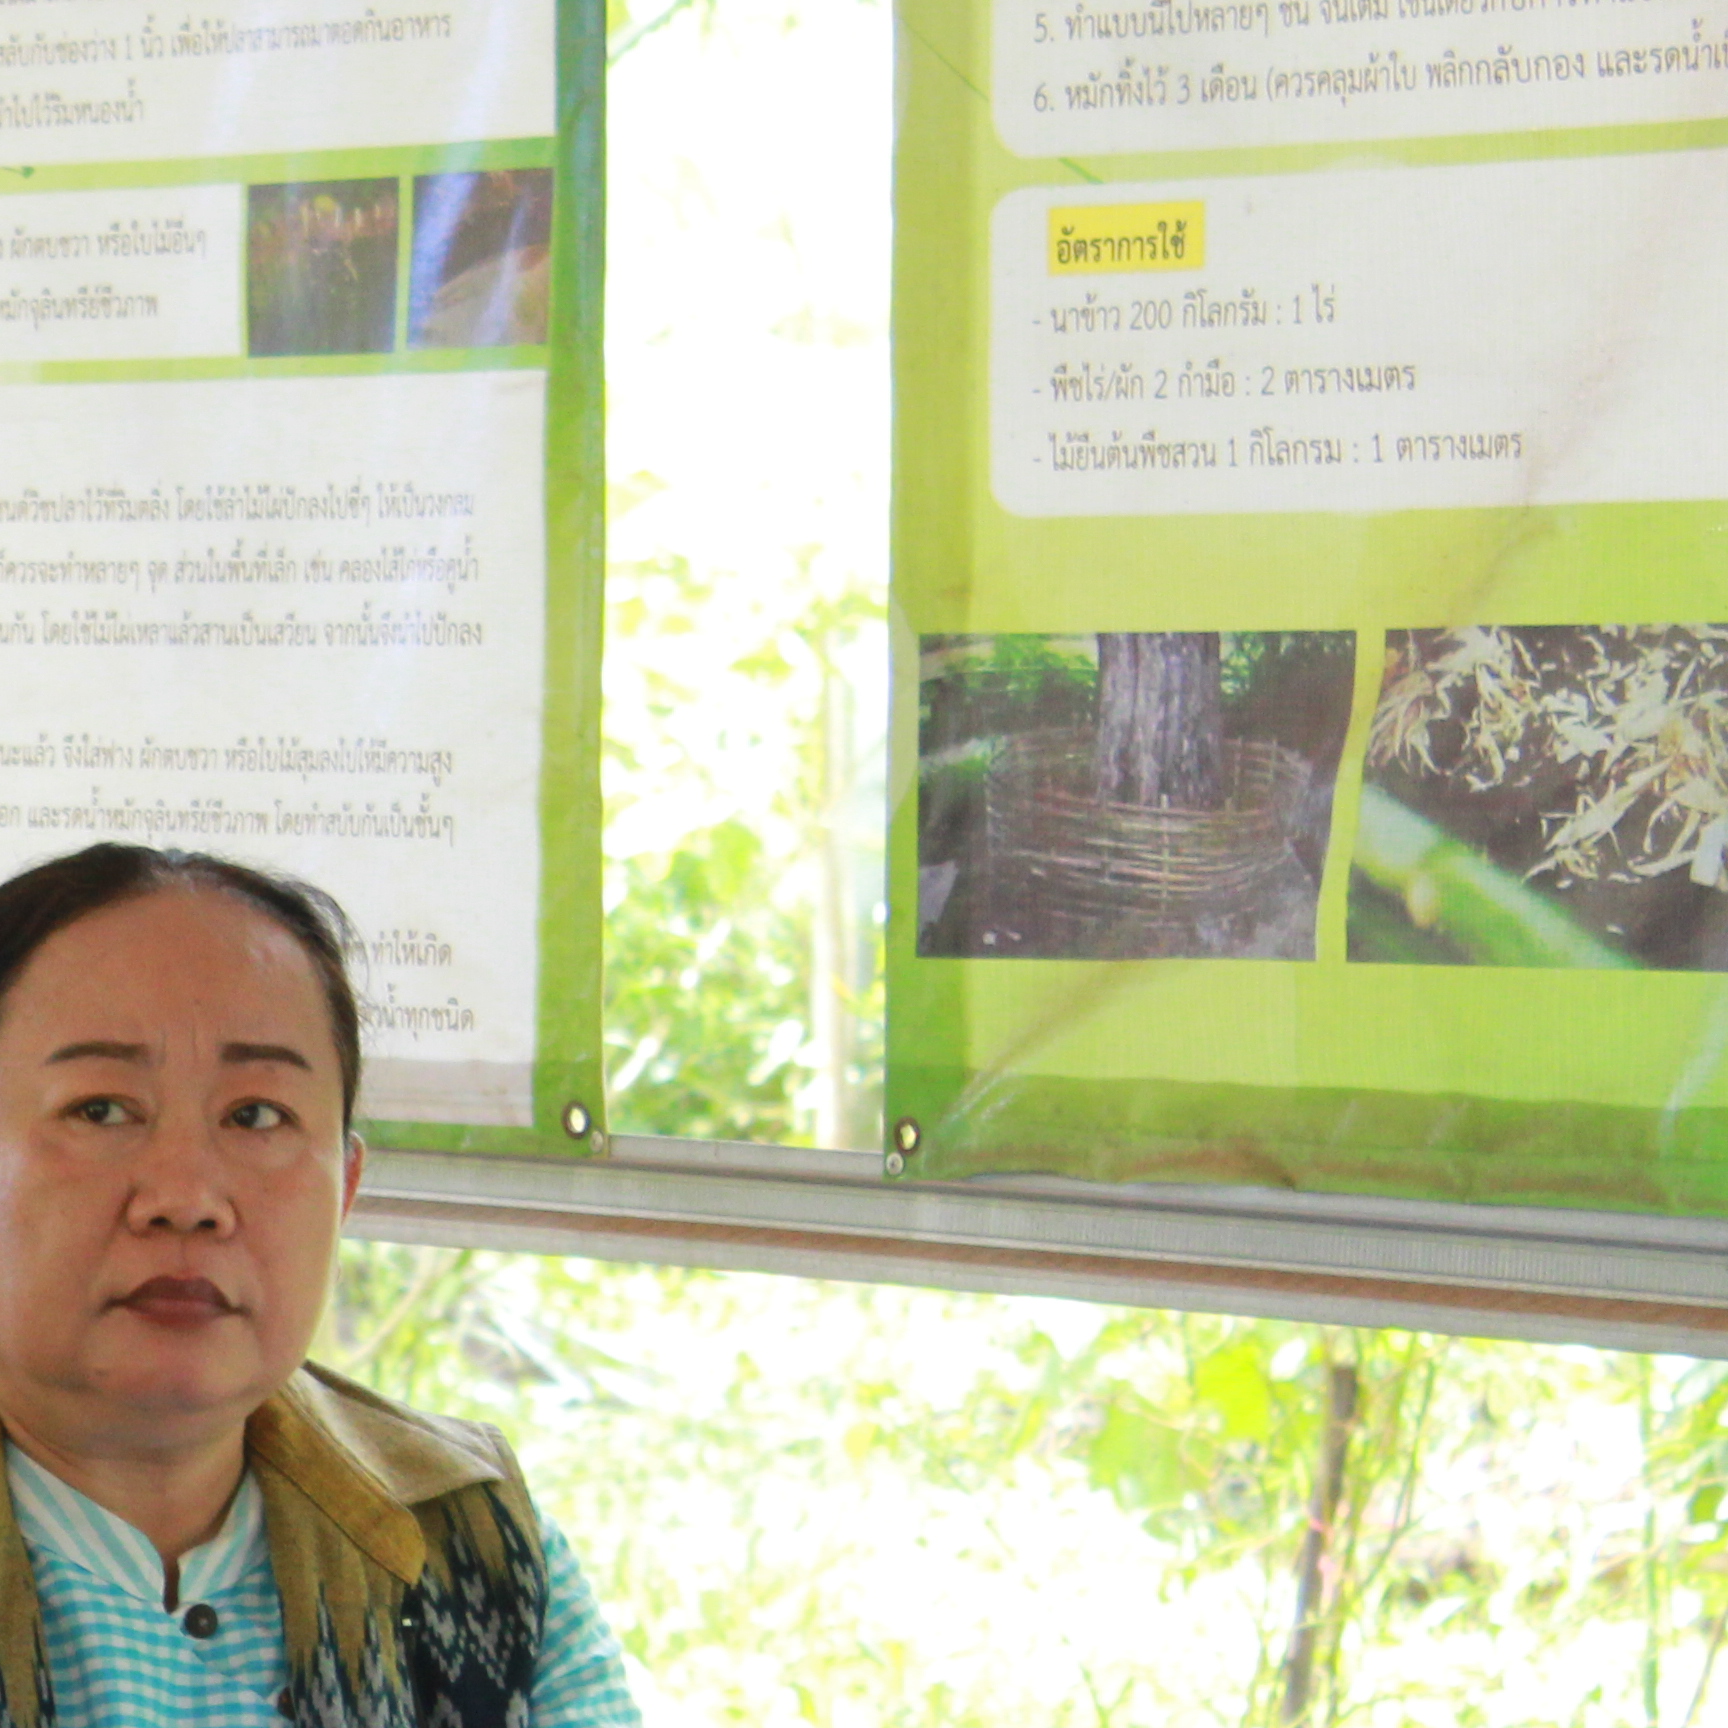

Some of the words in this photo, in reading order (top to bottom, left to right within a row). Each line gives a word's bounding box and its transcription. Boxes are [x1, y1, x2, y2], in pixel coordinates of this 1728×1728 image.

[125, 33, 132, 61] 1
[1033, 13, 1055, 43] 5.
[1033, 83, 1055, 112] 6.
[1065, 57, 1168, 111] หมักทิ้งไว้
[1176, 74, 1191, 105] 3
[1201, 63, 1257, 103] เดือน
[1266, 50, 1417, 108] (ควรคลุมผ้าใบ
[1426, 44, 1585, 90] พลิกกลับกอง
[9, 224, 90, 259] ผักตบชวา
[1056, 219, 1187, 265] อัตราการใช้
[1051, 292, 1121, 334] นาข้าว
[1129, 299, 1172, 331] 200
[1182, 288, 1267, 328] กิโลกรัม
[1292, 295, 1302, 325] 1
[1312, 283, 1335, 324] ไร่
[1050, 361, 1144, 402] พืชไร่/ผัก
[1154, 369, 1168, 400] 2
[1177, 358, 1236, 398] กำมือ
[1260, 366, 1275, 396] 2
[1284, 365, 1416, 395] ตารางเมตร
[1227, 437, 1238, 468] 1
[1372, 433, 1383, 463] 1
[1396, 431, 1522, 462] ตารางเมตร
[147, 560, 168, 594] จุด
[303, 548, 332, 583] เช่น
[372, 929, 451, 966] ทำให้เกิด
